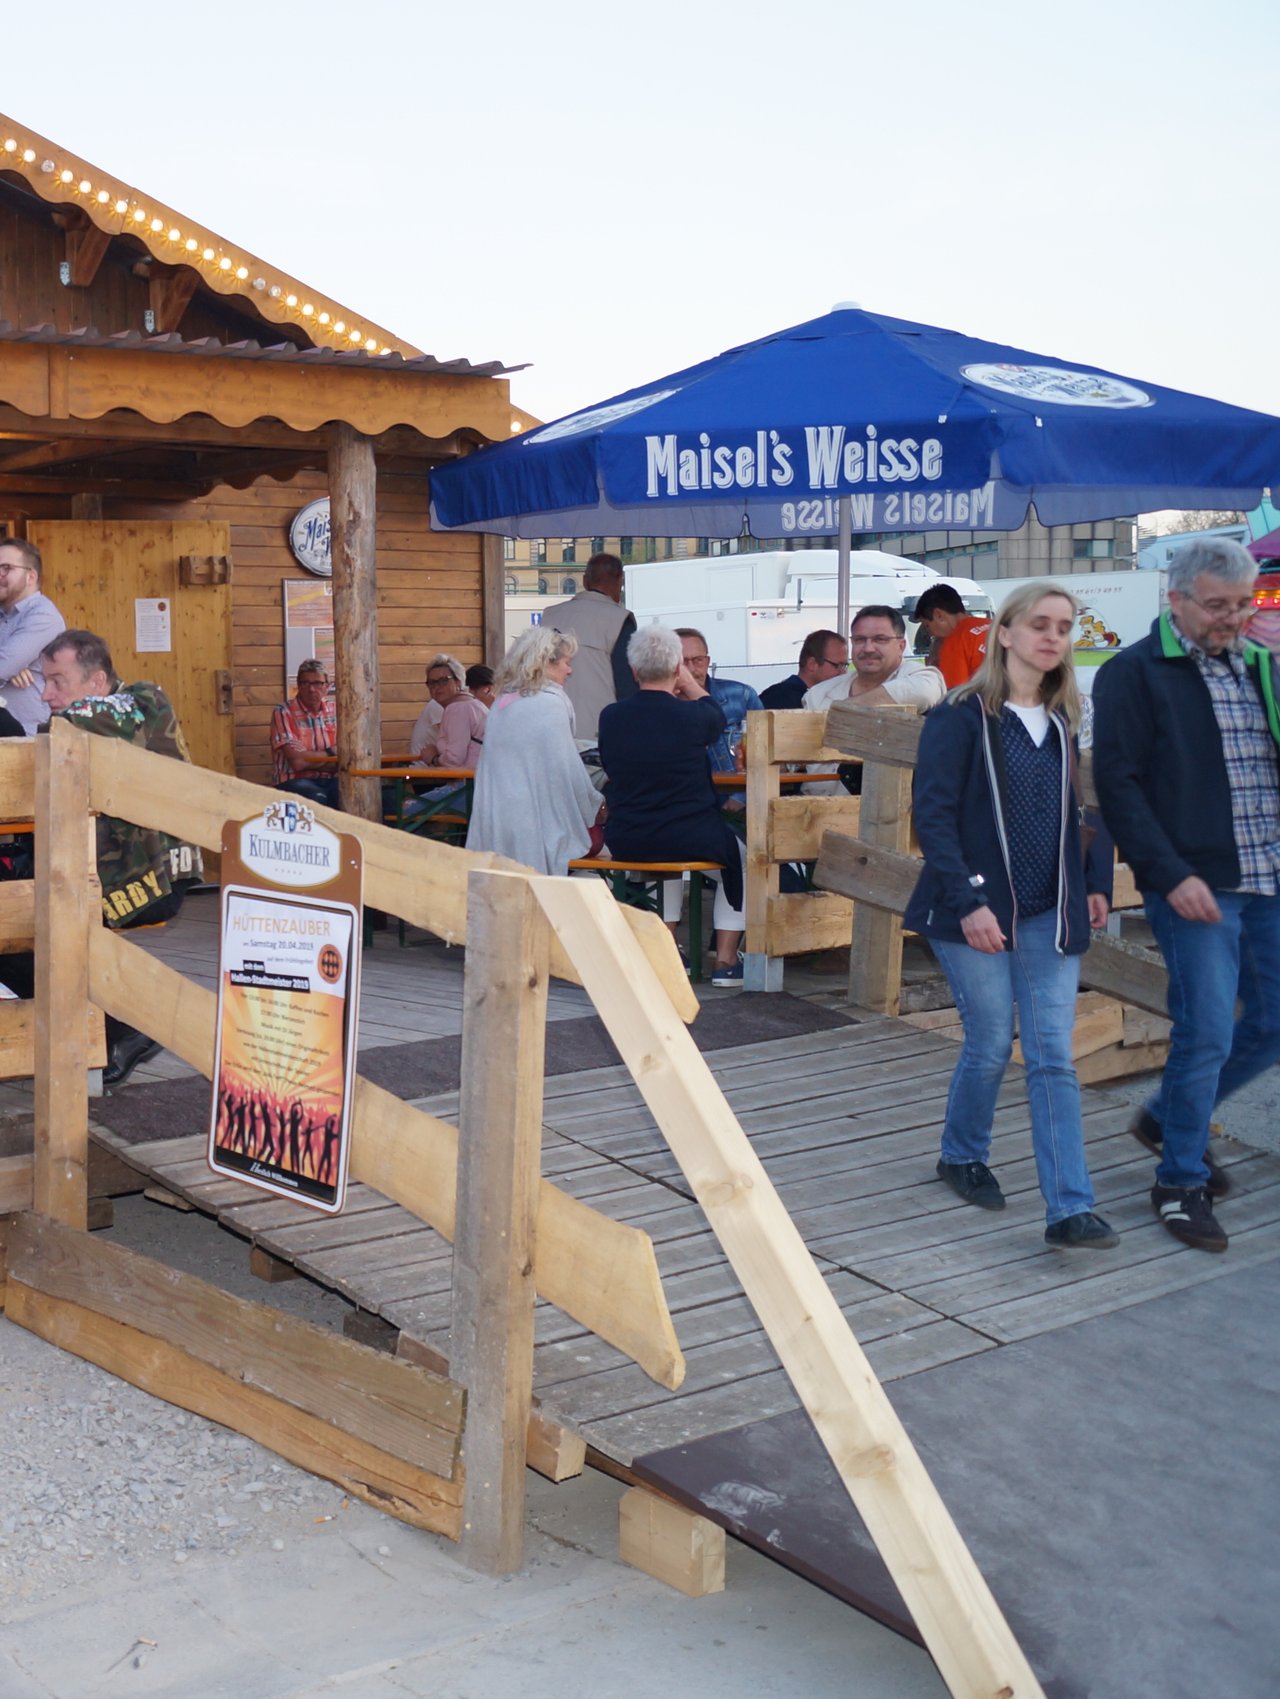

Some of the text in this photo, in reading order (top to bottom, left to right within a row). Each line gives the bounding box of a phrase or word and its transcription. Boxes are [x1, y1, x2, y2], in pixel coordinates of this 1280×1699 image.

[645, 424, 943, 497] Maisel's Weisse
[249, 833, 330, 867] KULMBACHER
[233, 913, 331, 937] HÜTTENZAUBER
